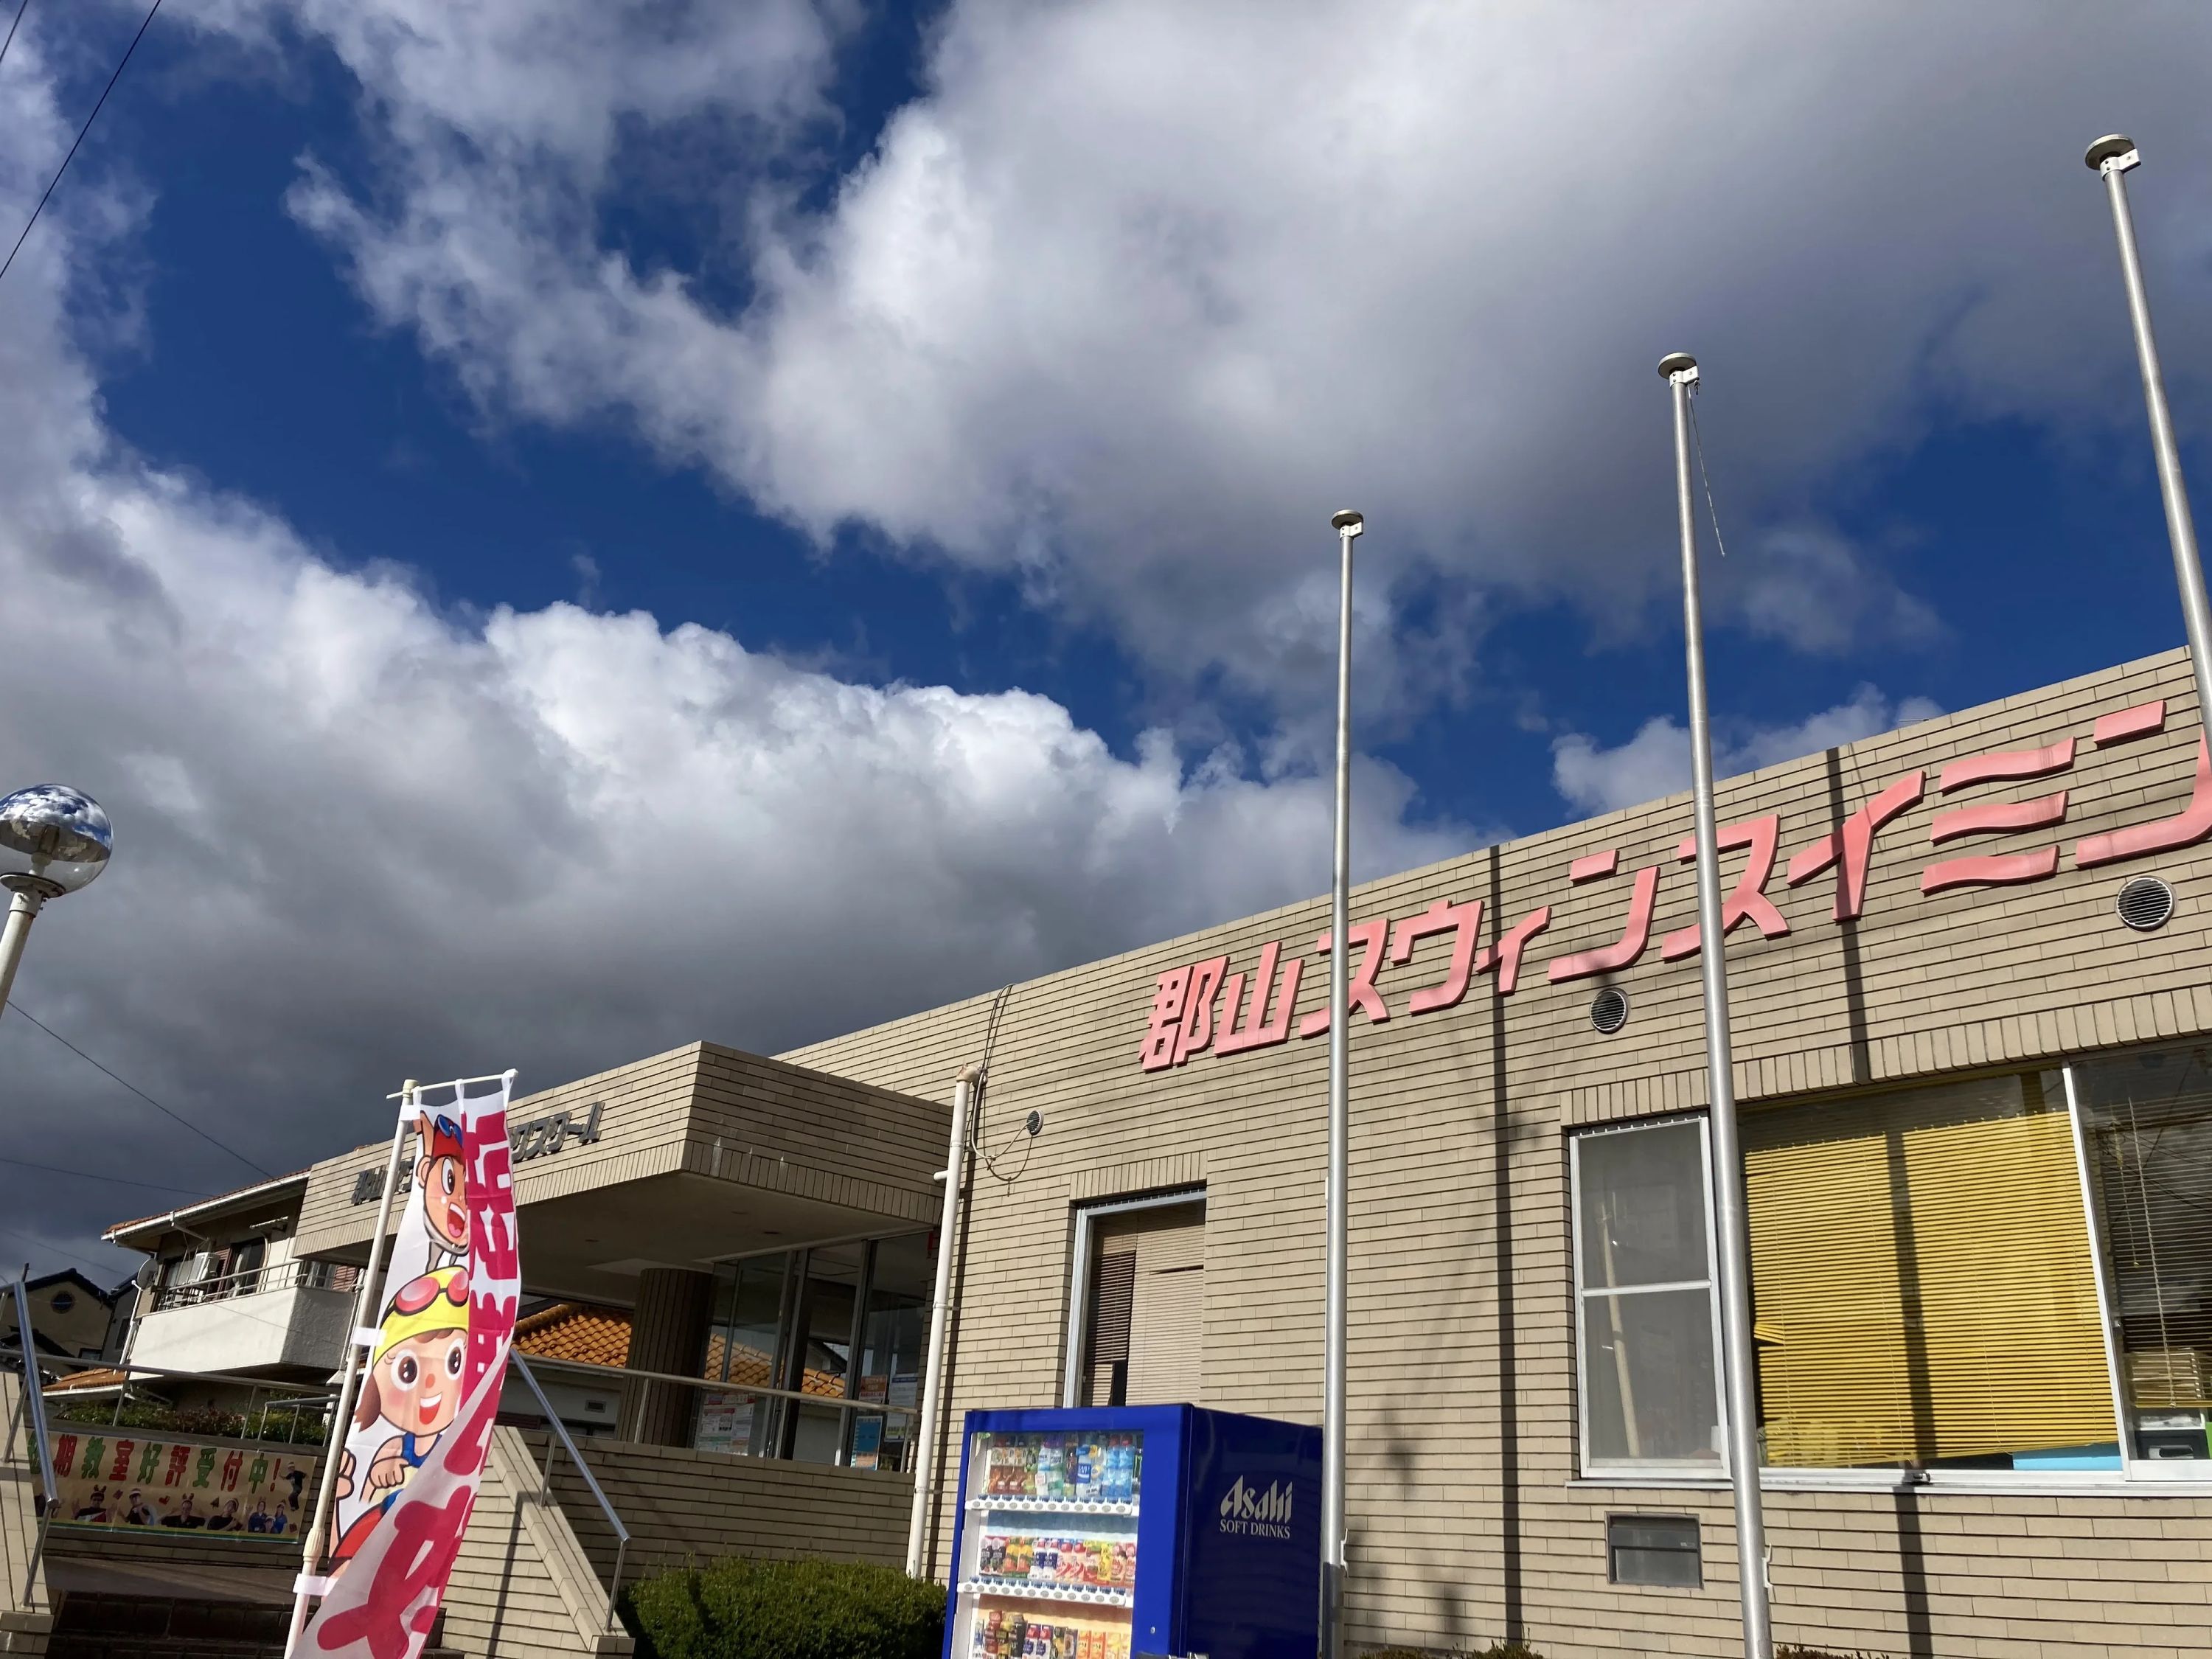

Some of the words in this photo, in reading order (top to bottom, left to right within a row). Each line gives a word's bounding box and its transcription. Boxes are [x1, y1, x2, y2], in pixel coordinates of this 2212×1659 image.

[1220, 1475, 1293, 1524] Asahi
[1220, 1519, 1248, 1534] SOFT
[1251, 1522, 1291, 1540] DRINKS
